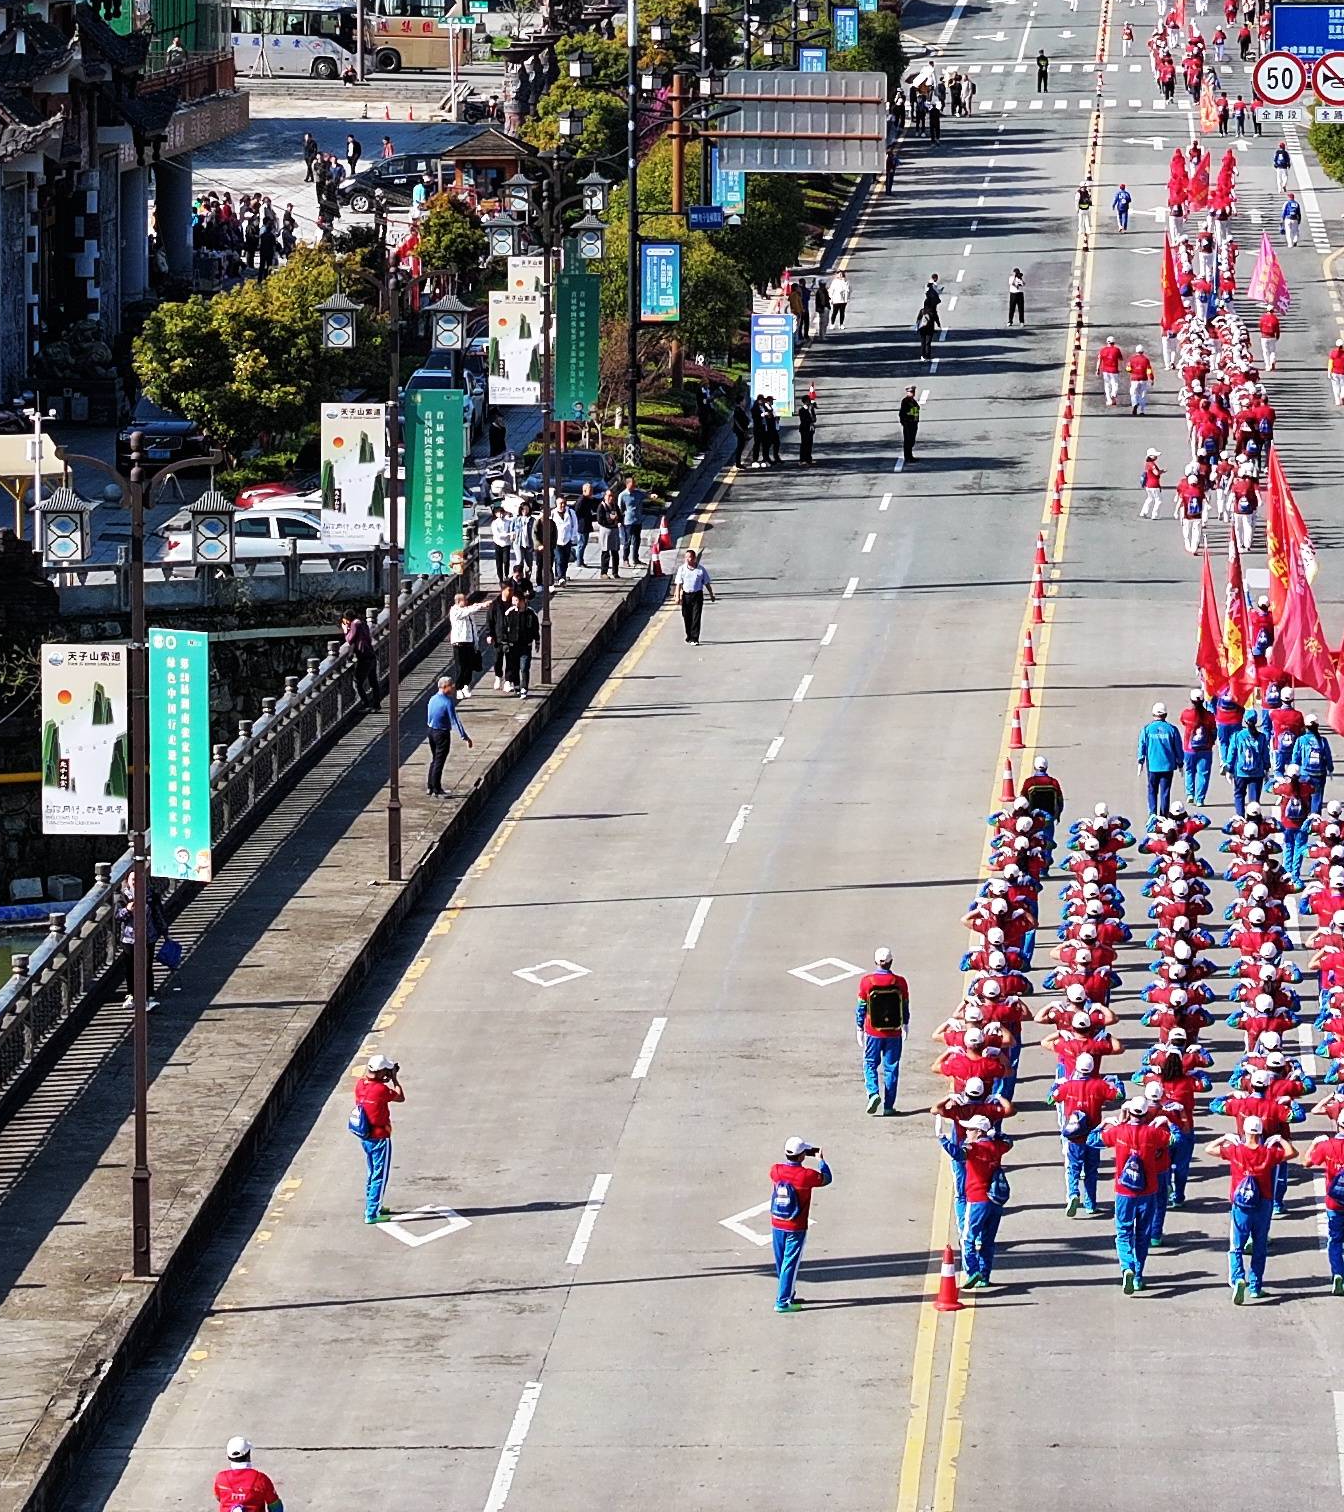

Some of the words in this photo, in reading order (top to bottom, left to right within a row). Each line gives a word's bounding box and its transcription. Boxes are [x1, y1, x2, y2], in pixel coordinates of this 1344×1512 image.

[1267, 67, 1293, 90] 50
[1262, 110, 1297, 120] 全路段
[67, 651, 121, 661] 天子山索道
